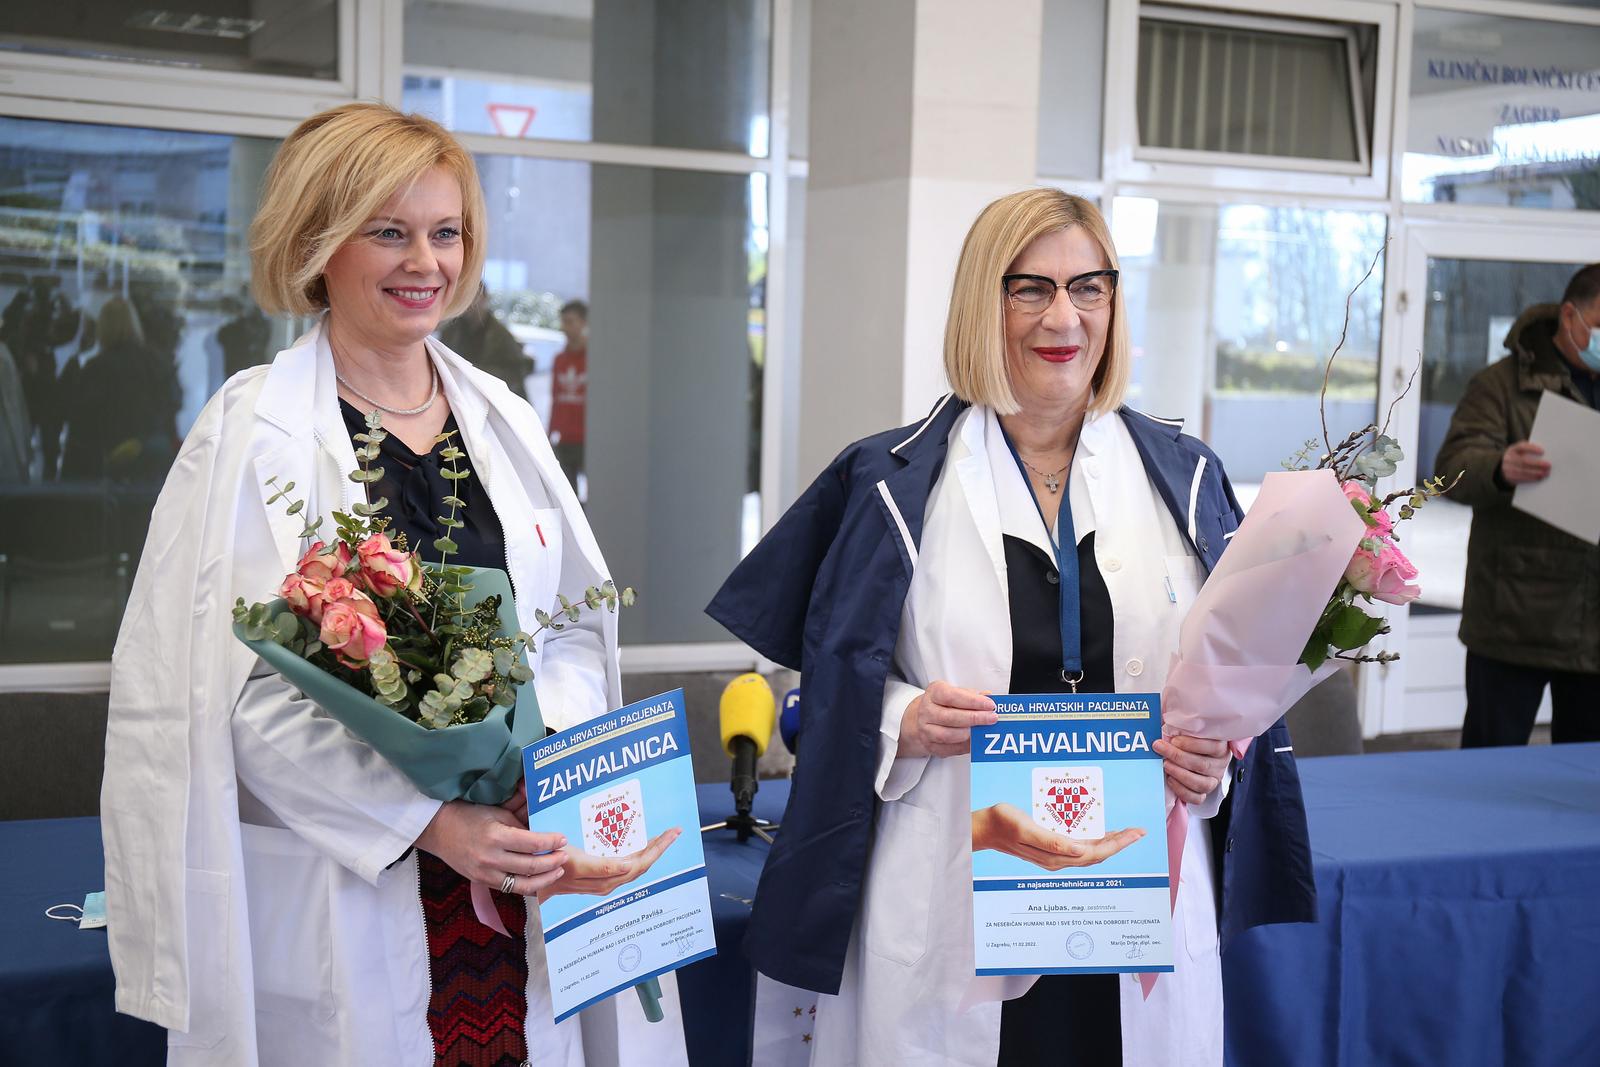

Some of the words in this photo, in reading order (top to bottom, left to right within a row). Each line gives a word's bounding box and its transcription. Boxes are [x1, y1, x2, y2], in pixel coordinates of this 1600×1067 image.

[1428, 57, 1498, 84] KLINIČKI
[1500, 104, 1560, 126] ZAGREB
[1029, 702, 1084, 712] HRVATSKIH
[1088, 700, 1149, 711] PACIJENATA
[533, 738, 567, 761] UDRUGA
[569, 719, 617, 744] HRVATSKIH
[620, 700, 674, 726] PACIJENATA
[984, 731, 1150, 755] ZAHVALNICA
[537, 731, 678, 803] ZAHVALNICA
[596, 795, 625, 810] HRVATSKIH
[1044, 802, 1063, 825] UDRUGA
[1071, 797, 1096, 829] PACIJENATA
[1027, 880, 1094, 890] najsestru-tehničara
[614, 918, 640, 932] Gordana
